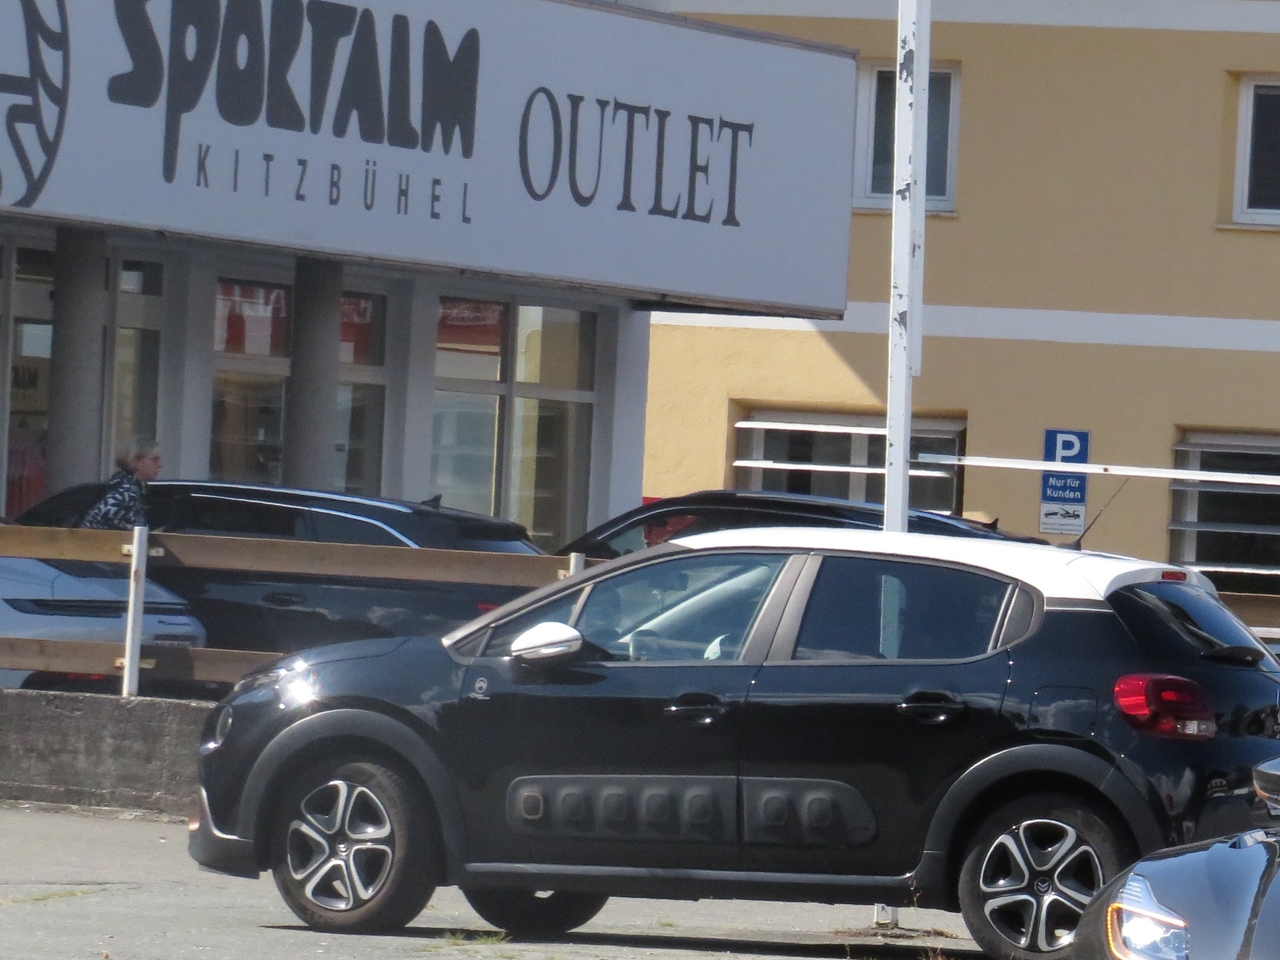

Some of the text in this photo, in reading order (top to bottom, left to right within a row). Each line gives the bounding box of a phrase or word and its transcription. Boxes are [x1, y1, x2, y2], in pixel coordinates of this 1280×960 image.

[518, 86, 754, 227] OUTLET
[196, 143, 472, 224] KITZBÜHEL
[1055, 433, 1080, 462] P
[1046, 487, 1081, 499] Kunden
[1049, 477, 1080, 488] Nur für
